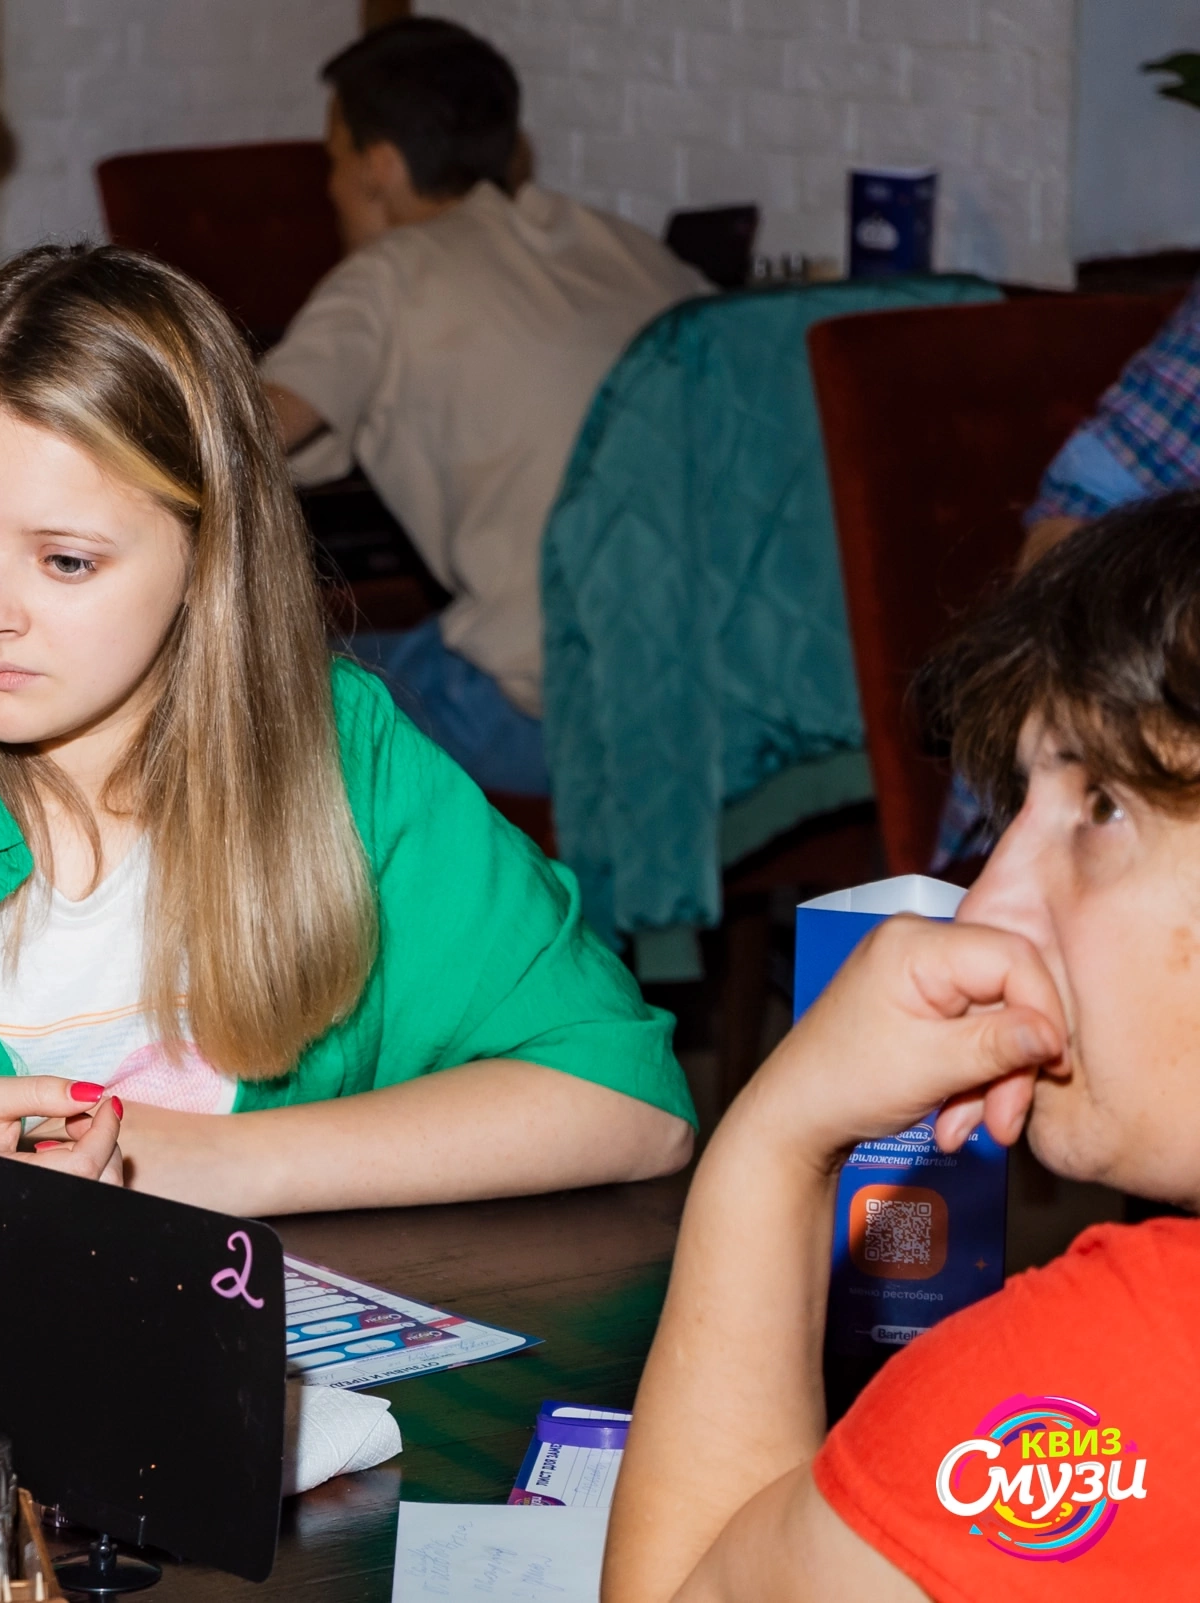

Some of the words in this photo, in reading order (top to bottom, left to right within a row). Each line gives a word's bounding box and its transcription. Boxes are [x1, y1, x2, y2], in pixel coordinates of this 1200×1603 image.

[873, 1142, 931, 1154] напитков
[211, 1230, 264, 1309] 2
[882, 1288, 944, 1302] рестобара
[546, 1443, 562, 1459] ЗАМЕ
